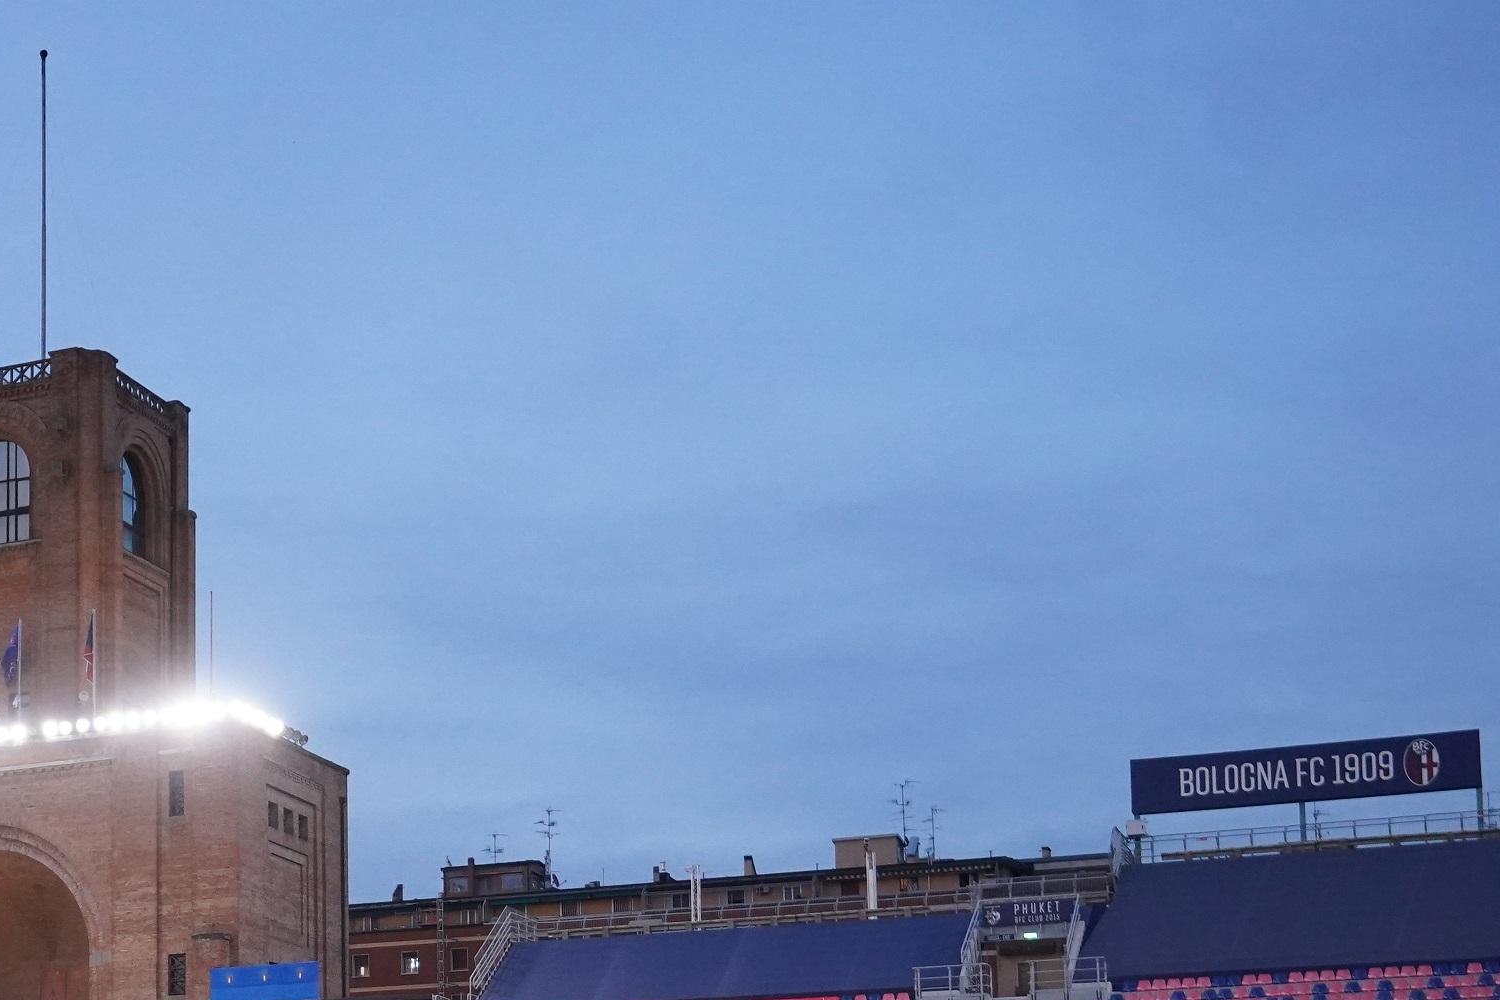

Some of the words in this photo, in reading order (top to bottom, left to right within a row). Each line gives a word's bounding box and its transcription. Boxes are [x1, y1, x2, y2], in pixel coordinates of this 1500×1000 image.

[1178, 759, 1290, 798] BOLOGNA
[1296, 757, 1325, 787] FC
[1331, 750, 1394, 785] 1909
[1014, 900, 1060, 915] PHUKET
[1028, 915, 1043, 923] CLUB
